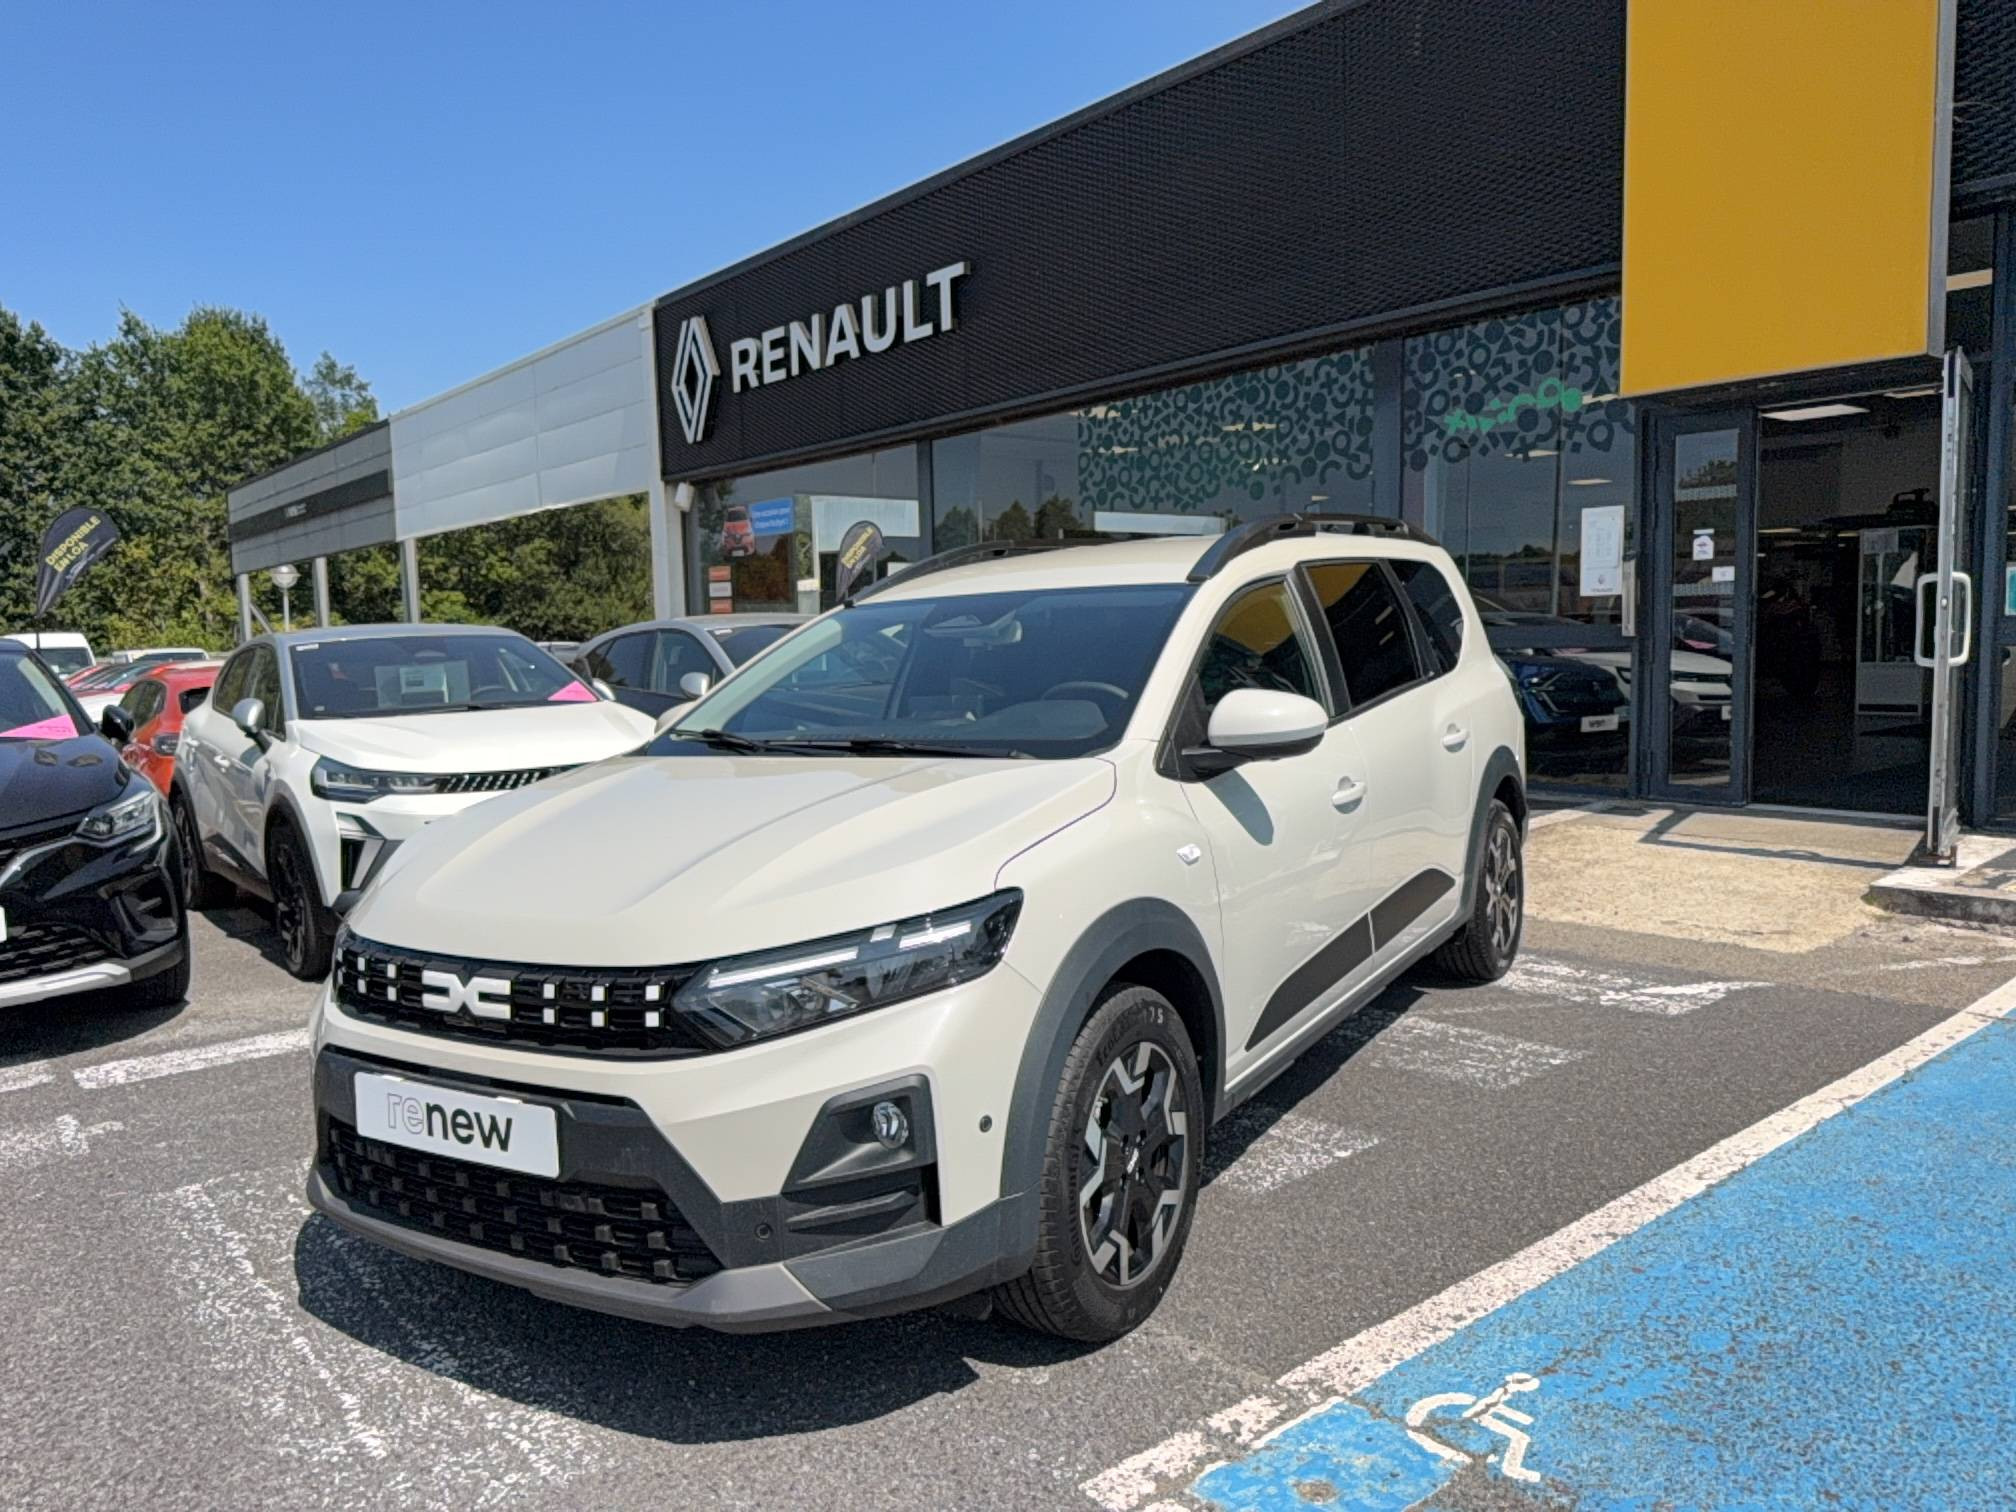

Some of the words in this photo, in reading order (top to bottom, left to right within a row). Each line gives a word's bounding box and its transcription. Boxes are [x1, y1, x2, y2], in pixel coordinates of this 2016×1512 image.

[730, 261, 967, 393] RENAULT
[45, 515, 101, 566] DISPONIBLE
[386, 1093, 513, 1152] renew
